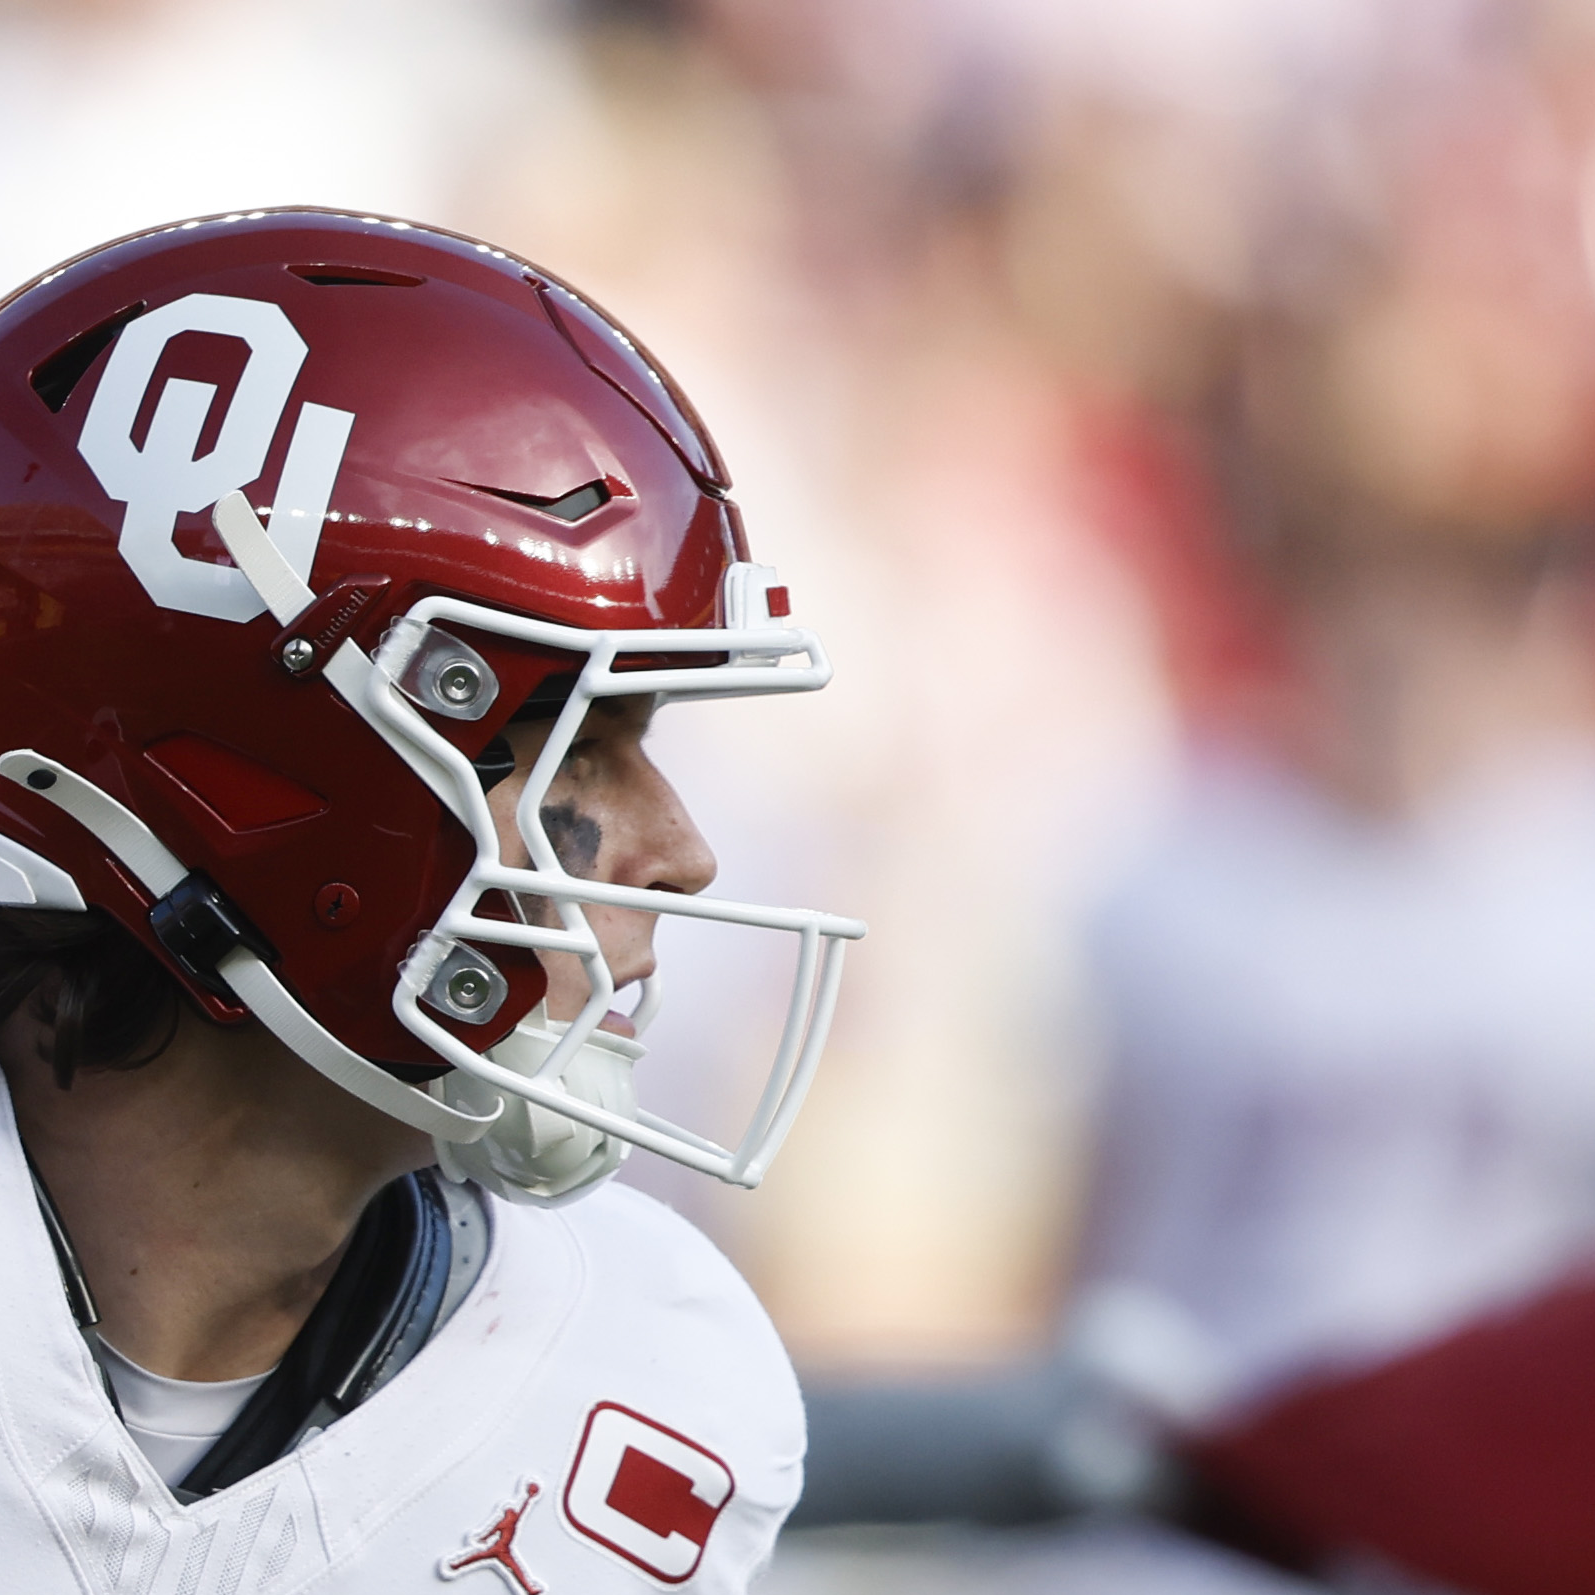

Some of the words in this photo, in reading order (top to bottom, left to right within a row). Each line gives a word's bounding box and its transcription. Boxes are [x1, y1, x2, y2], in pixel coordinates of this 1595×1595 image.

[77, 293, 356, 624] OU
[313, 589, 370, 649] Riddell
[565, 1400, 735, 1585] C
